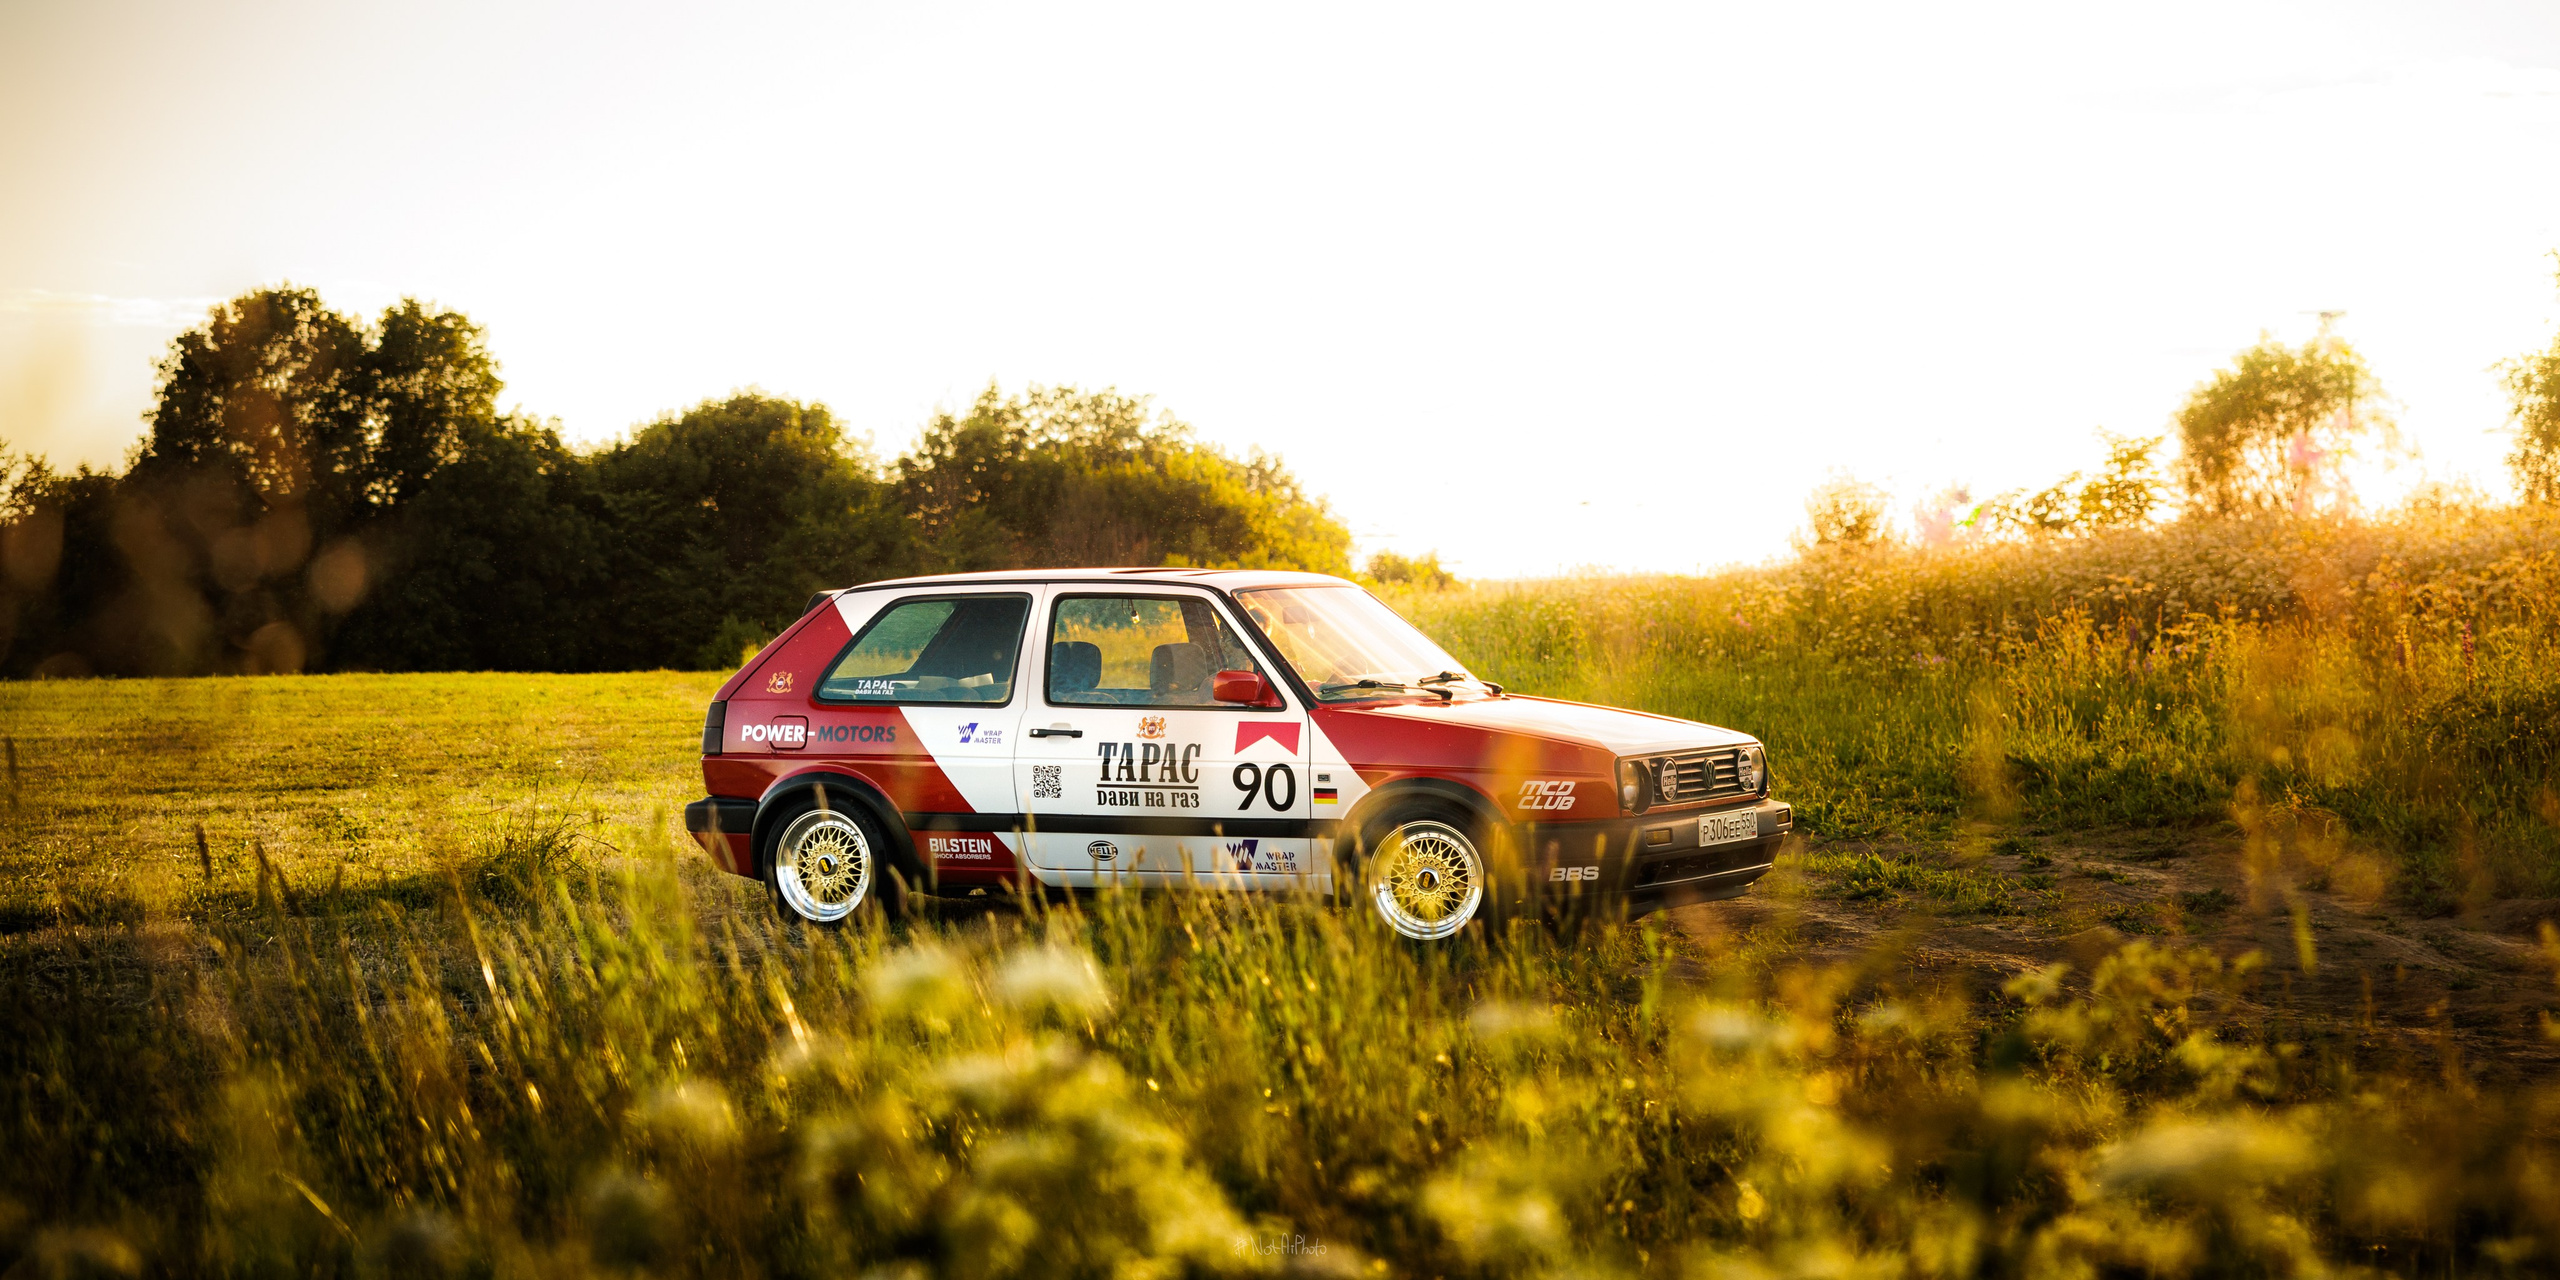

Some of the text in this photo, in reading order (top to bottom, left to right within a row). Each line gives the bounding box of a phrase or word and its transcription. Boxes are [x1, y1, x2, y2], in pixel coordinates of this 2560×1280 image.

[1232, 763, 1296, 812] 90
[1518, 780, 1576, 796] MCD
[1517, 795, 1576, 810] CLUB
[929, 838, 992, 853] BILSTEIN
[1090, 846, 1118, 856] HELLA
[1266, 852, 1295, 860] WRAP
[1256, 862, 1297, 871] MASTER
[1549, 866, 1599, 882] BBS
